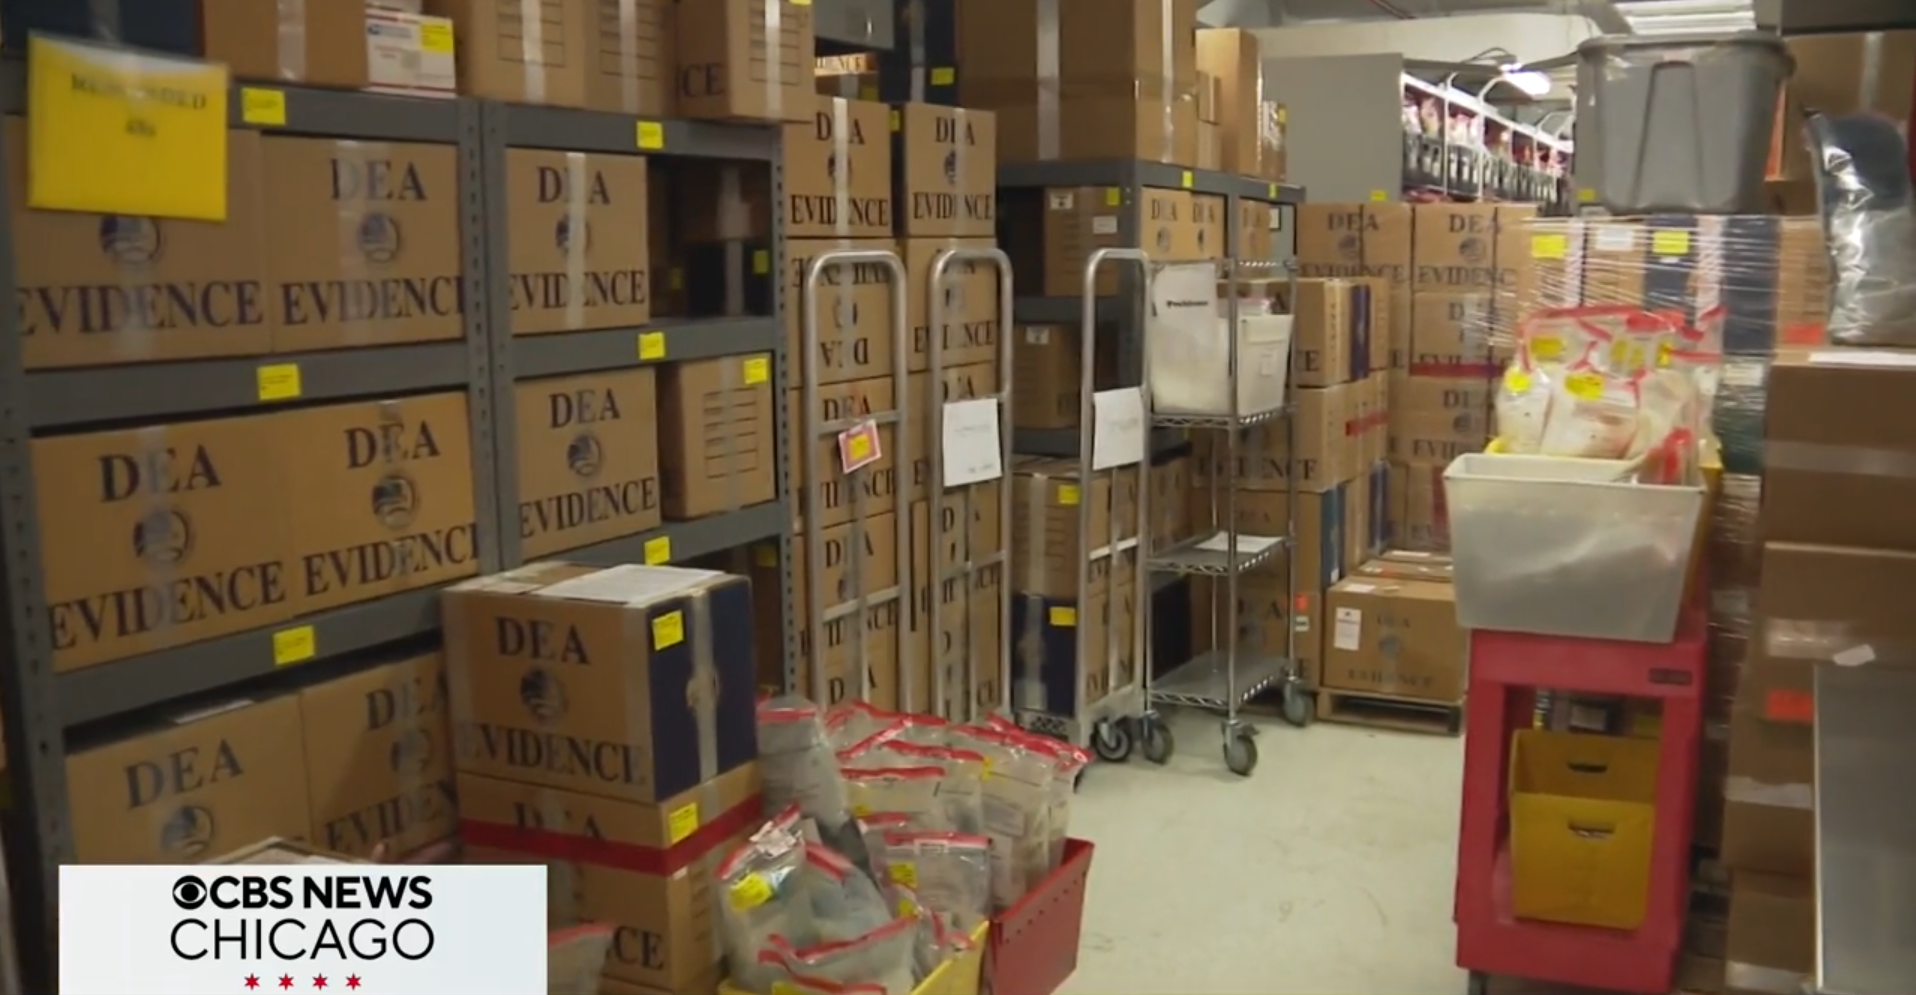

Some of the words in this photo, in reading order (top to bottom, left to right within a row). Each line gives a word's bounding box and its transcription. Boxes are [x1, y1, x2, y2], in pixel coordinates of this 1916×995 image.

[816, 112, 865, 145] DA
[330, 158, 427, 202] DEA
[537, 165, 610, 206] DA
[549, 387, 621, 429] DEA
[344, 420, 441, 470] DEA
[97, 443, 222, 503] DEA
[518, 476, 657, 539] EVIDENCE
[47, 560, 288, 651] EVIDENCE
[494, 616, 591, 665] DEA
[124, 737, 245, 810] DEA
